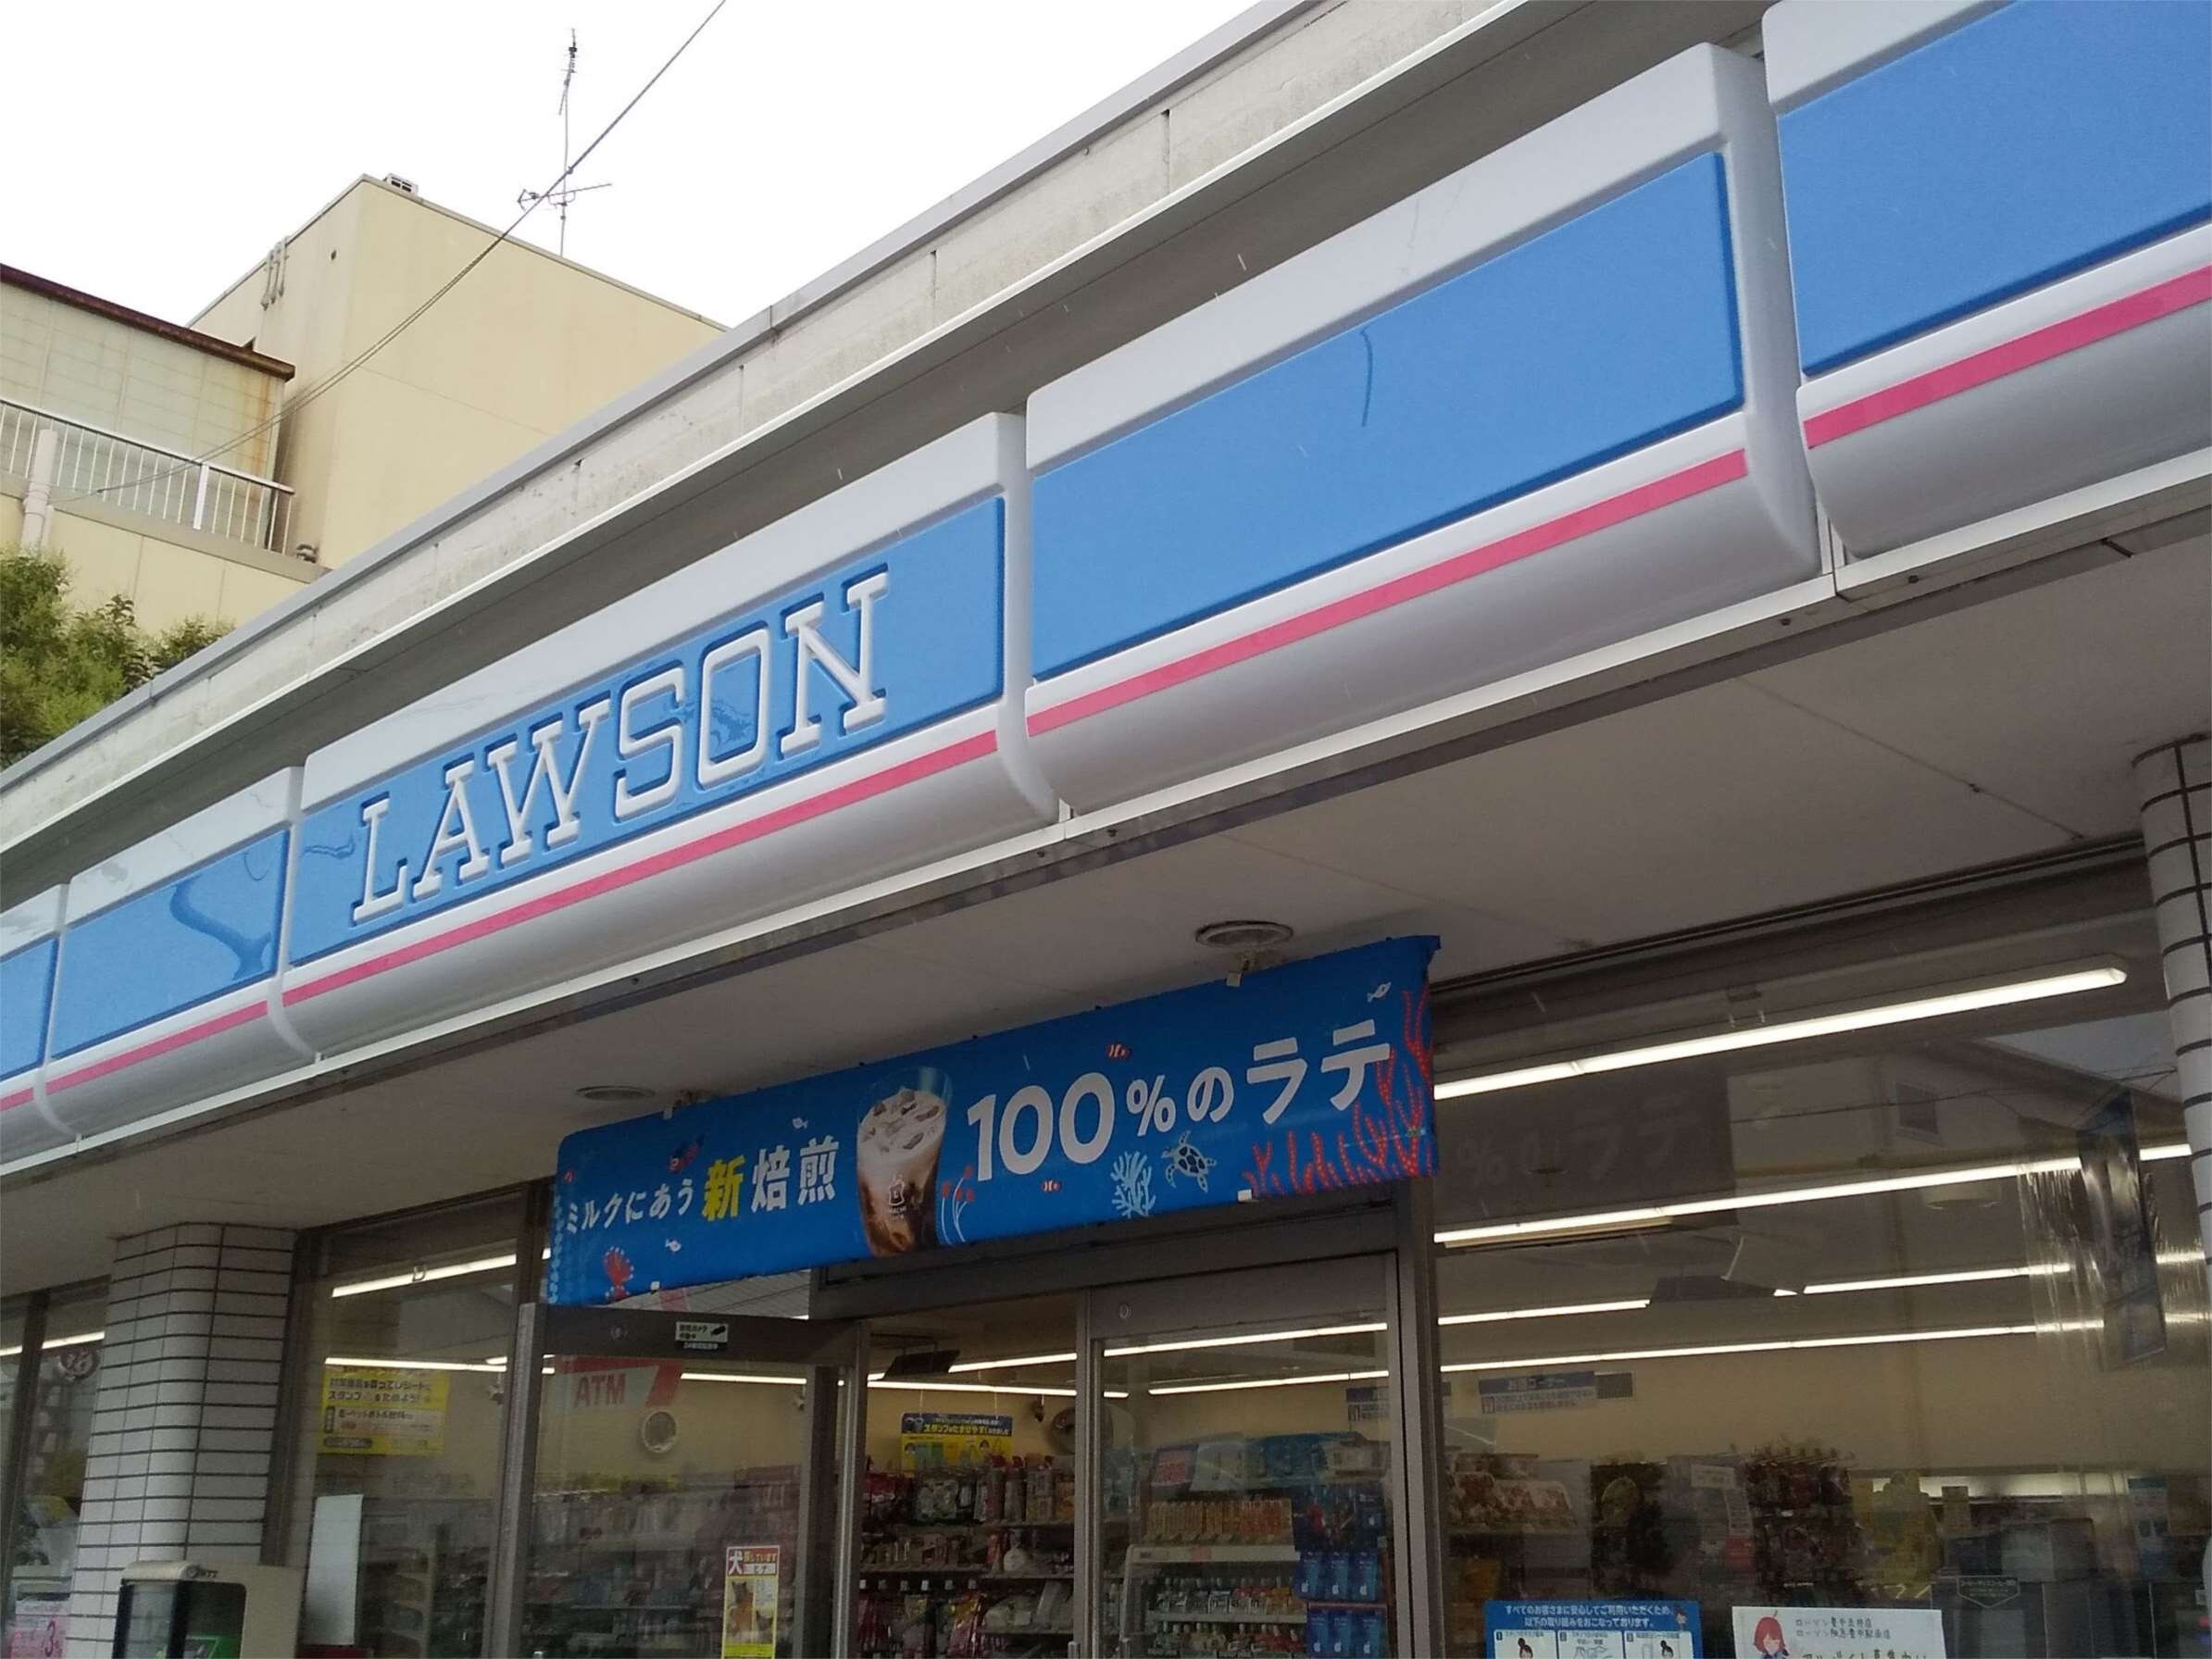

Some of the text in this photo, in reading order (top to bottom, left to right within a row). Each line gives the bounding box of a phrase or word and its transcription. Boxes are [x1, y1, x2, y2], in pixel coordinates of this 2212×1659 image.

[352, 567, 888, 925] LAWSON
[574, 1374, 627, 1407] ATM
[729, 1551, 744, 1574] 犬
